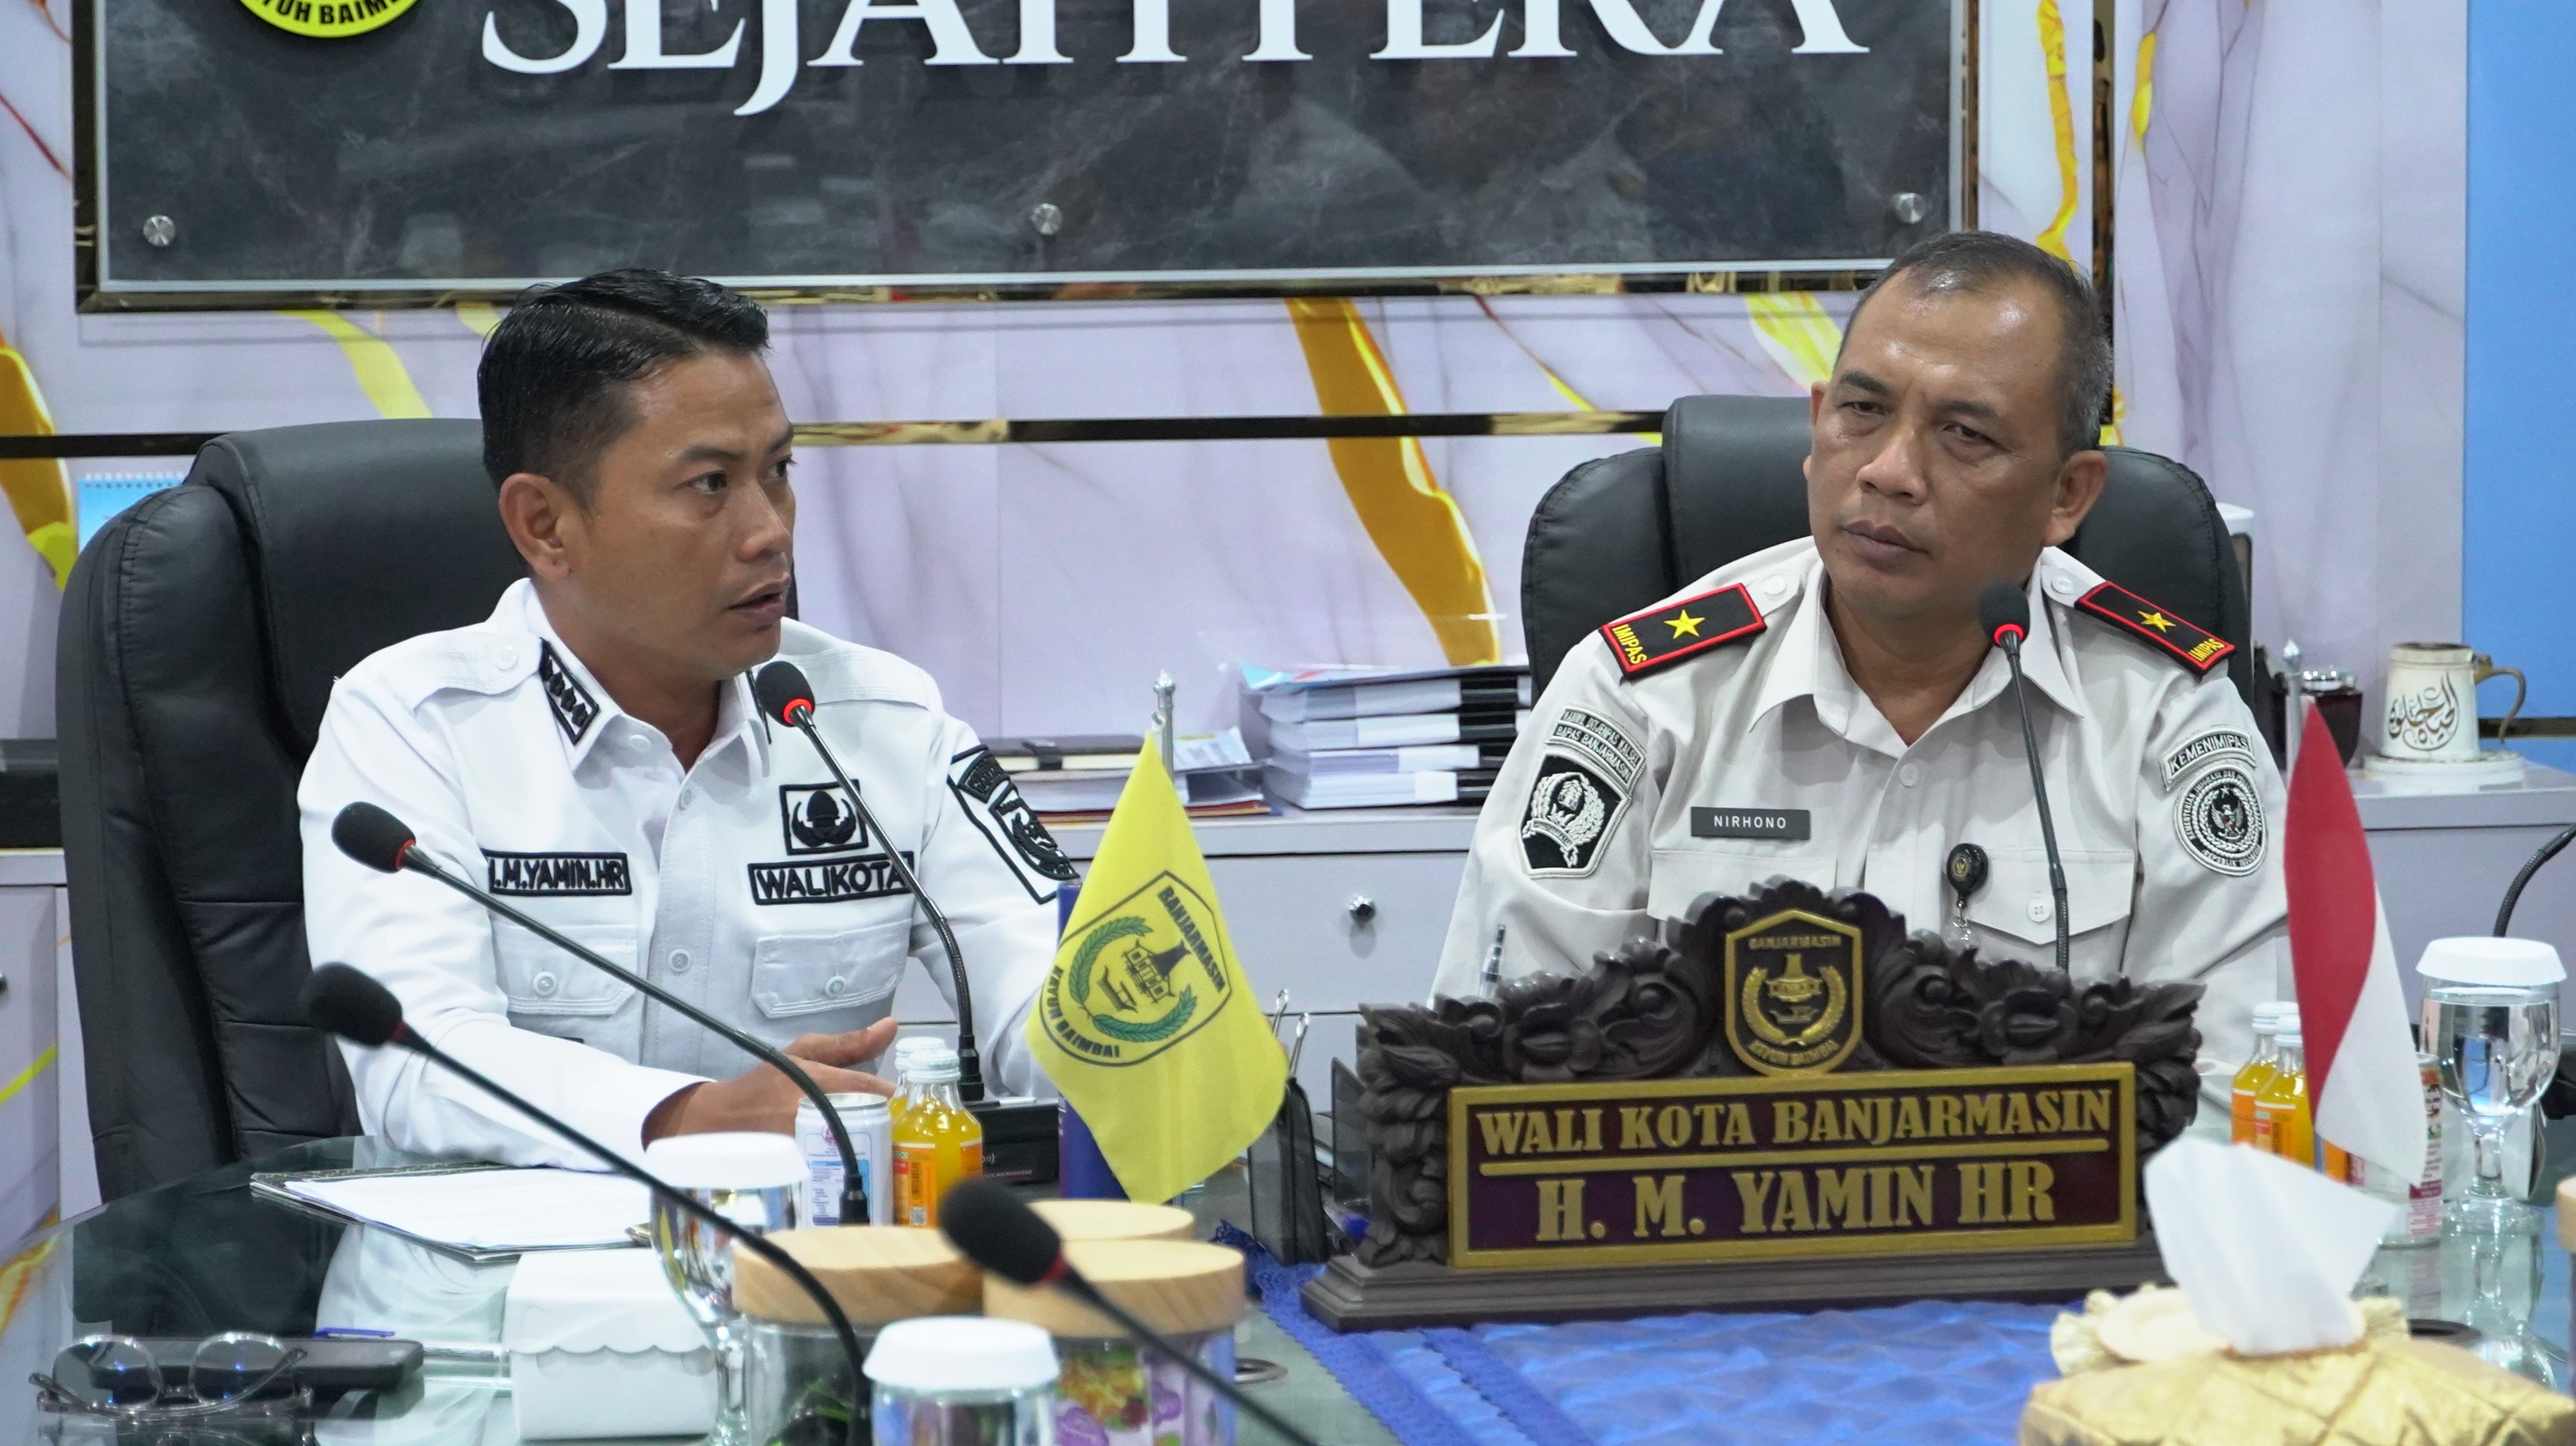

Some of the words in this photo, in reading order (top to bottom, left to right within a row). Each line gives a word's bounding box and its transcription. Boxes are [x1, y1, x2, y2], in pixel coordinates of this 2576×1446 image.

[1612, 624, 1648, 665] IMIPAS
[2188, 638, 2226, 662] IMIPAS
[1580, 733, 1631, 781] BANJARMASIN
[2169, 734, 2249, 773] KEMENIMIPAS
[1714, 815, 1786, 829] NIRHONO
[756, 861, 907, 899] WALIKOTA
[1157, 885, 1226, 993] BANJARMASIN
[1046, 965, 1064, 1019] KAYUH
[1055, 1019, 1120, 1058] BAIMBAI
[1476, 1107, 1603, 1156] WALI
[1619, 1101, 1756, 1150] KOTA
[1772, 1090, 2112, 1145] BANJARMASIN
[1535, 1179, 1607, 1243] H.
[1632, 1174, 1706, 1237] M.
[1731, 1165, 1935, 1234] YAMIN
[1958, 1160, 2056, 1224] HR
